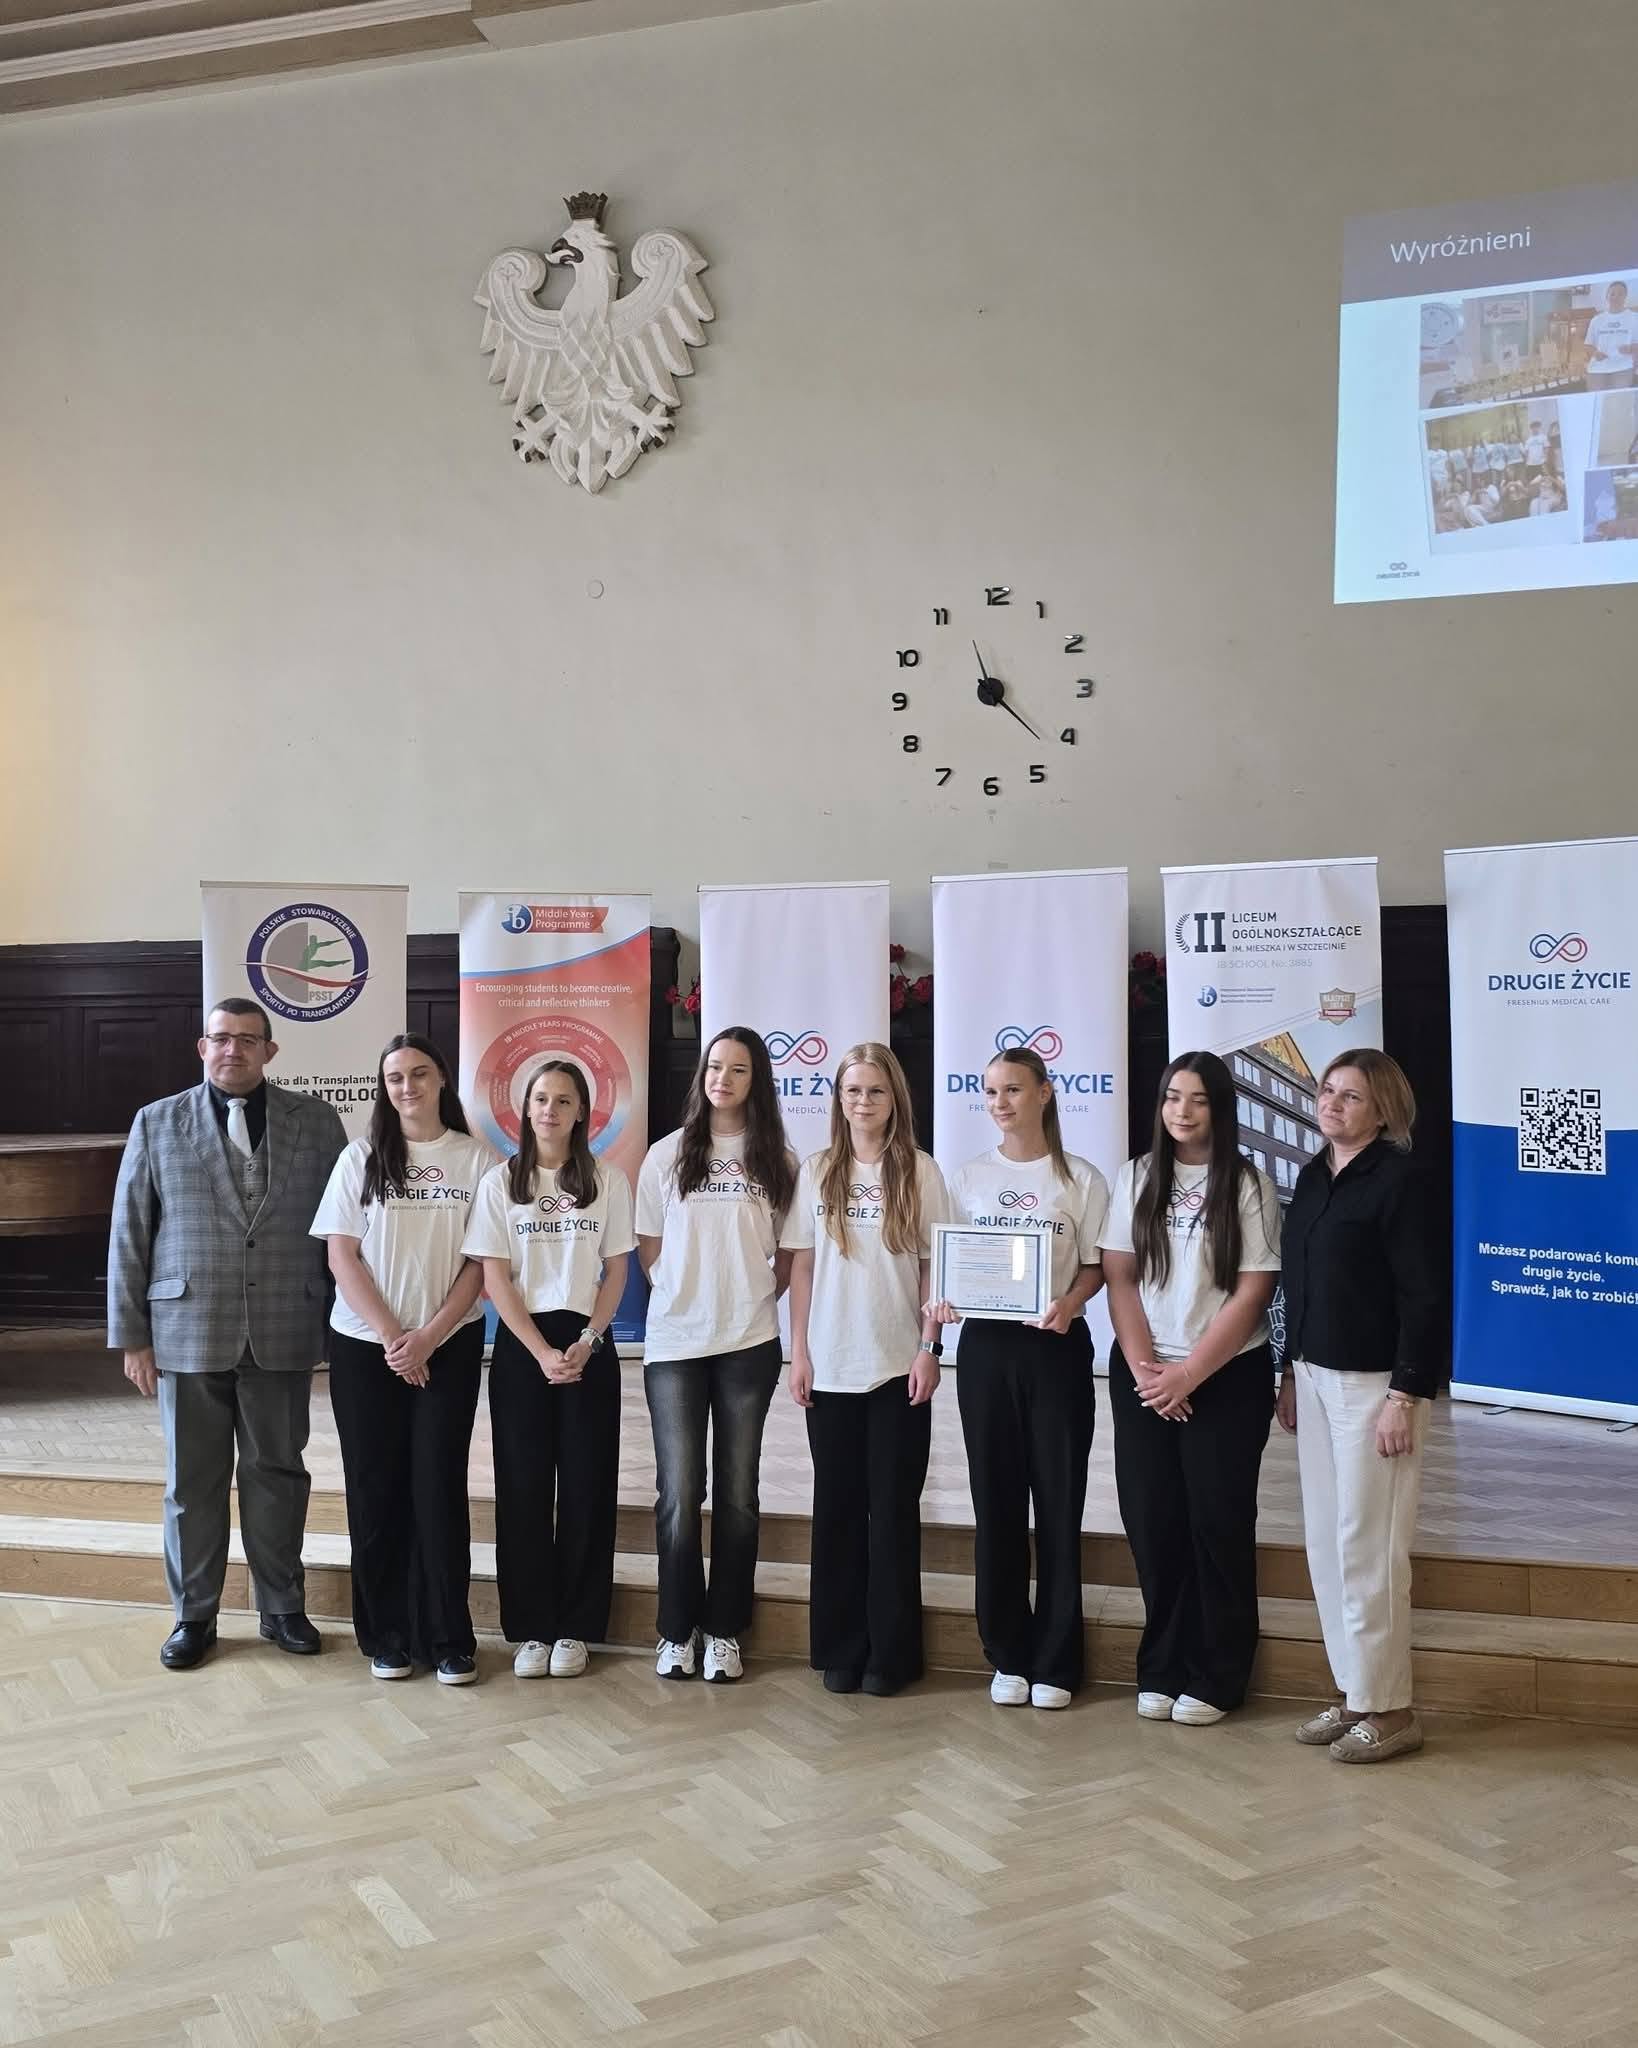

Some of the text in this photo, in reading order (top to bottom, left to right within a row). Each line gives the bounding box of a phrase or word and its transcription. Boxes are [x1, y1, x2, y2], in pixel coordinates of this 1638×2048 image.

[1391, 226, 1531, 264] Wyróżnieni
[985, 586, 1010, 606] 12
[933, 608, 949, 625] 11
[1036, 601, 1045, 618] 1
[1064, 634, 1084, 653] 2
[896, 649, 919, 667] 10
[1076, 679, 1094, 698] 3
[891, 692, 907, 711] 9
[903, 735, 919, 753] 8
[1060, 728, 1076, 745] 4
[935, 768, 952, 786] 7
[1029, 765, 1045, 783] 5
[983, 777, 999, 796] 6
[535, 909, 594, 918] Middle Years
[1232, 912, 1277, 923] LICEUM
[259, 907, 356, 940] POLSKIE STOWARZYSZENIE
[535, 920, 590, 930] Programme
[1194, 912, 1226, 952] II
[1232, 925, 1362, 941] OGÓLNOKSZTAŁCĄCE
[1232, 945, 1245, 953] IM.
[1246, 944, 1281, 952] MIESZKA
[1287, 943, 1297, 951] W
[1297, 942, 1347, 951] SZCZECINIE
[1227, 960, 1270, 969] SCHOOL
[1488, 969, 1631, 990] DRUGIE ŻYCIE
[310, 991, 334, 1001] PSST
[476, 983, 523, 995] Encouraging
[525, 984, 558, 993] students
[560, 984, 568, 993] to
[570, 984, 599, 993] become
[260, 988, 356, 1017] SPORTU PO TRANSPLANTACJI
[498, 998, 610, 1008] critical and reflective thinkers
[267, 1075, 377, 1087] lska dla Transplanto
[335, 1104, 353, 1113] lski
[787, 1106, 828, 1114] MEDICAL
[432, 1186, 471, 1203] ŻYCIE
[516, 1217, 600, 1235] DRUGIE ŻYCIE
[1478, 1242, 1638, 1267] Możesz podarować komu
[1522, 1265, 1605, 1283] drugie życie.
[1491, 1280, 1550, 1298] Sprawdź,
[1552, 1286, 1572, 1299] jak
[1575, 1288, 1589, 1299] to
